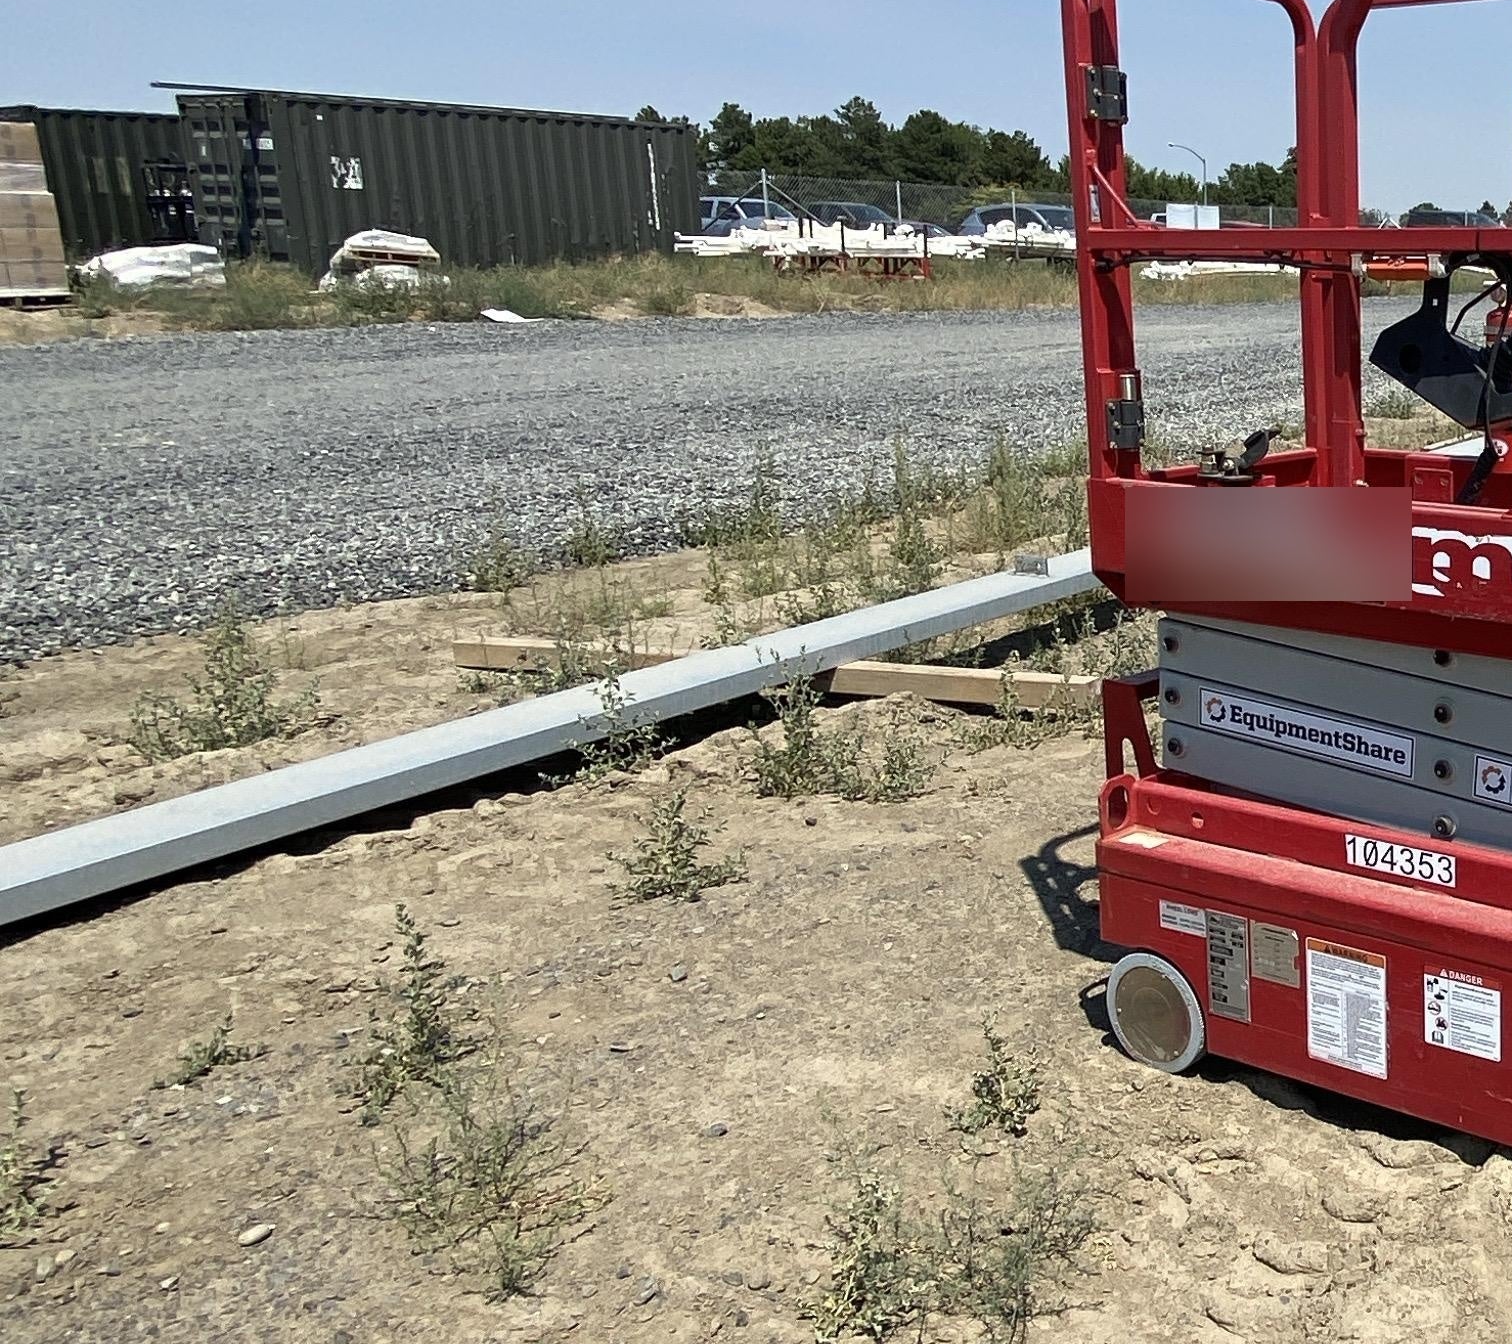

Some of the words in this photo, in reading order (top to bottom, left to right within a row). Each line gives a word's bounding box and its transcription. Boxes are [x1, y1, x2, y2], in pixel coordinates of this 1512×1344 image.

[1229, 703, 1406, 765] EquipmentShare
[1347, 836, 1453, 884] 104353
[1448, 970, 1484, 986] DANGER
